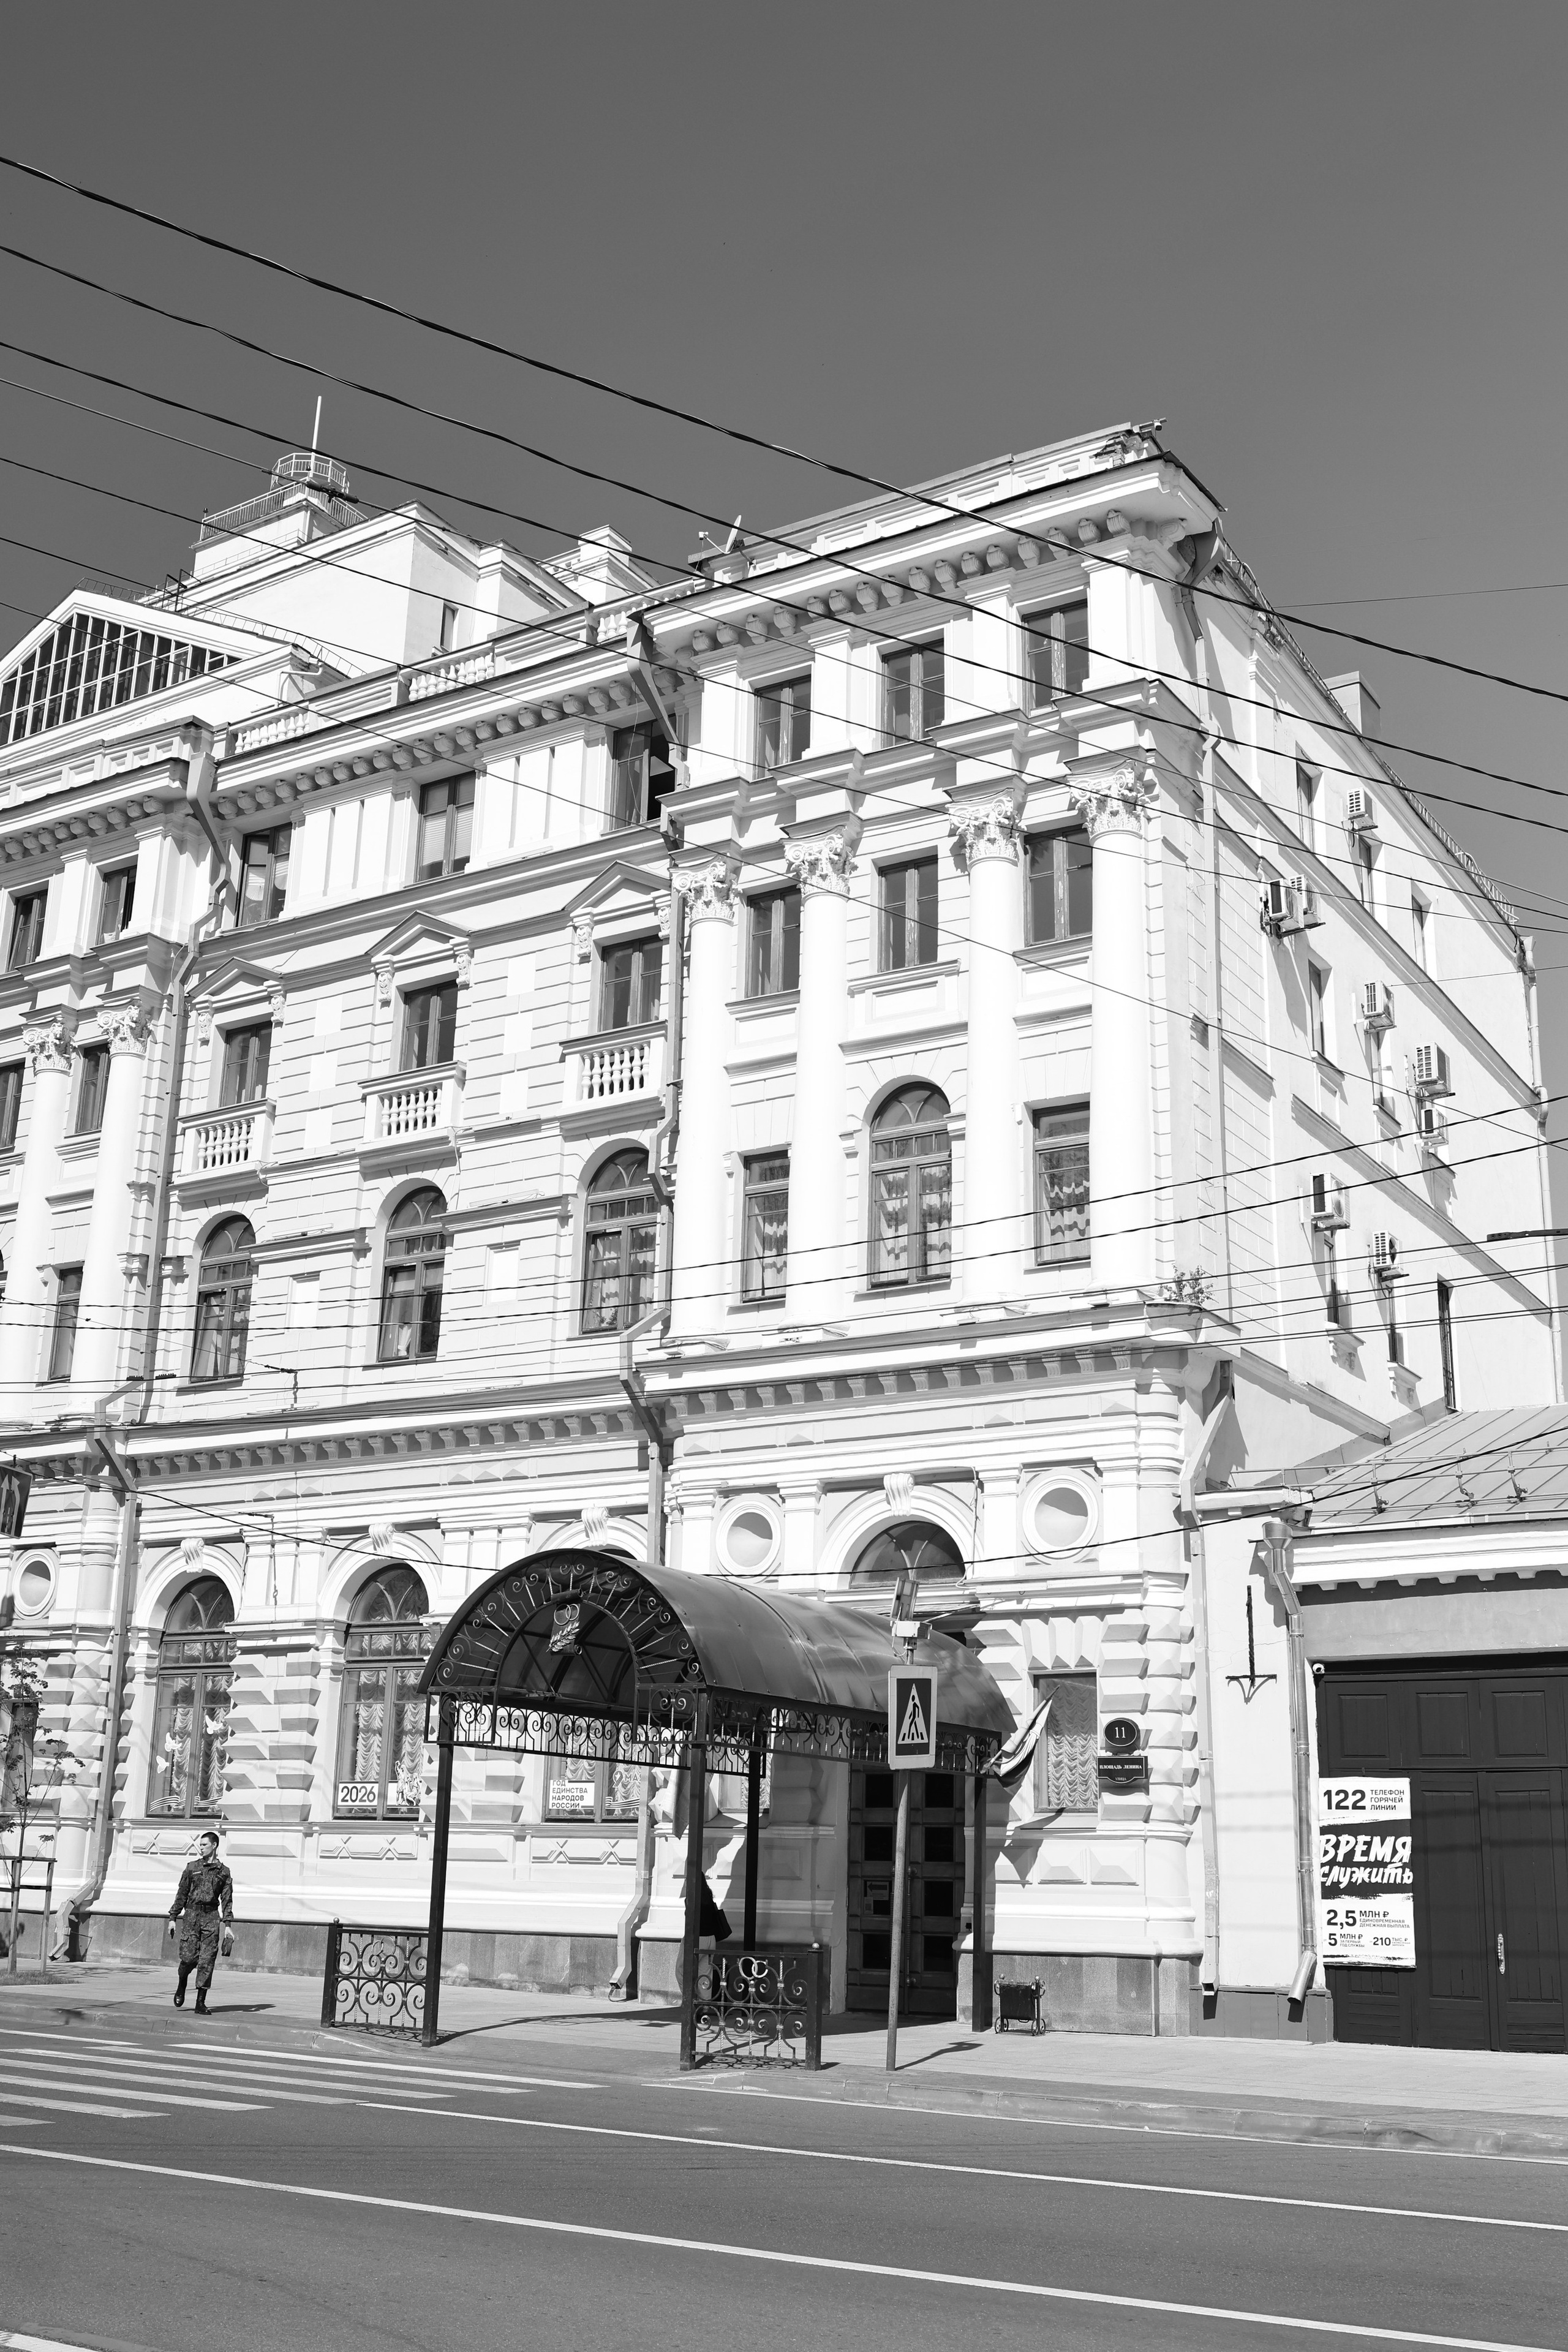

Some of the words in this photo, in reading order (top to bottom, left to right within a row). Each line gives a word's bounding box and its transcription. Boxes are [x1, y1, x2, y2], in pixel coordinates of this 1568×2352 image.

[1115, 1727, 1126, 1738] 11
[624, 1772, 641, 1782] МА
[341, 1785, 376, 1803] 2026
[1324, 1789, 1366, 1810] 122
[1320, 1834, 1412, 1863] ВРЕМЯ
[1327, 1909, 1357, 1929] 2,5
[1328, 1933, 1338, 1947] 5
[1373, 1937, 1391, 1946] 210
